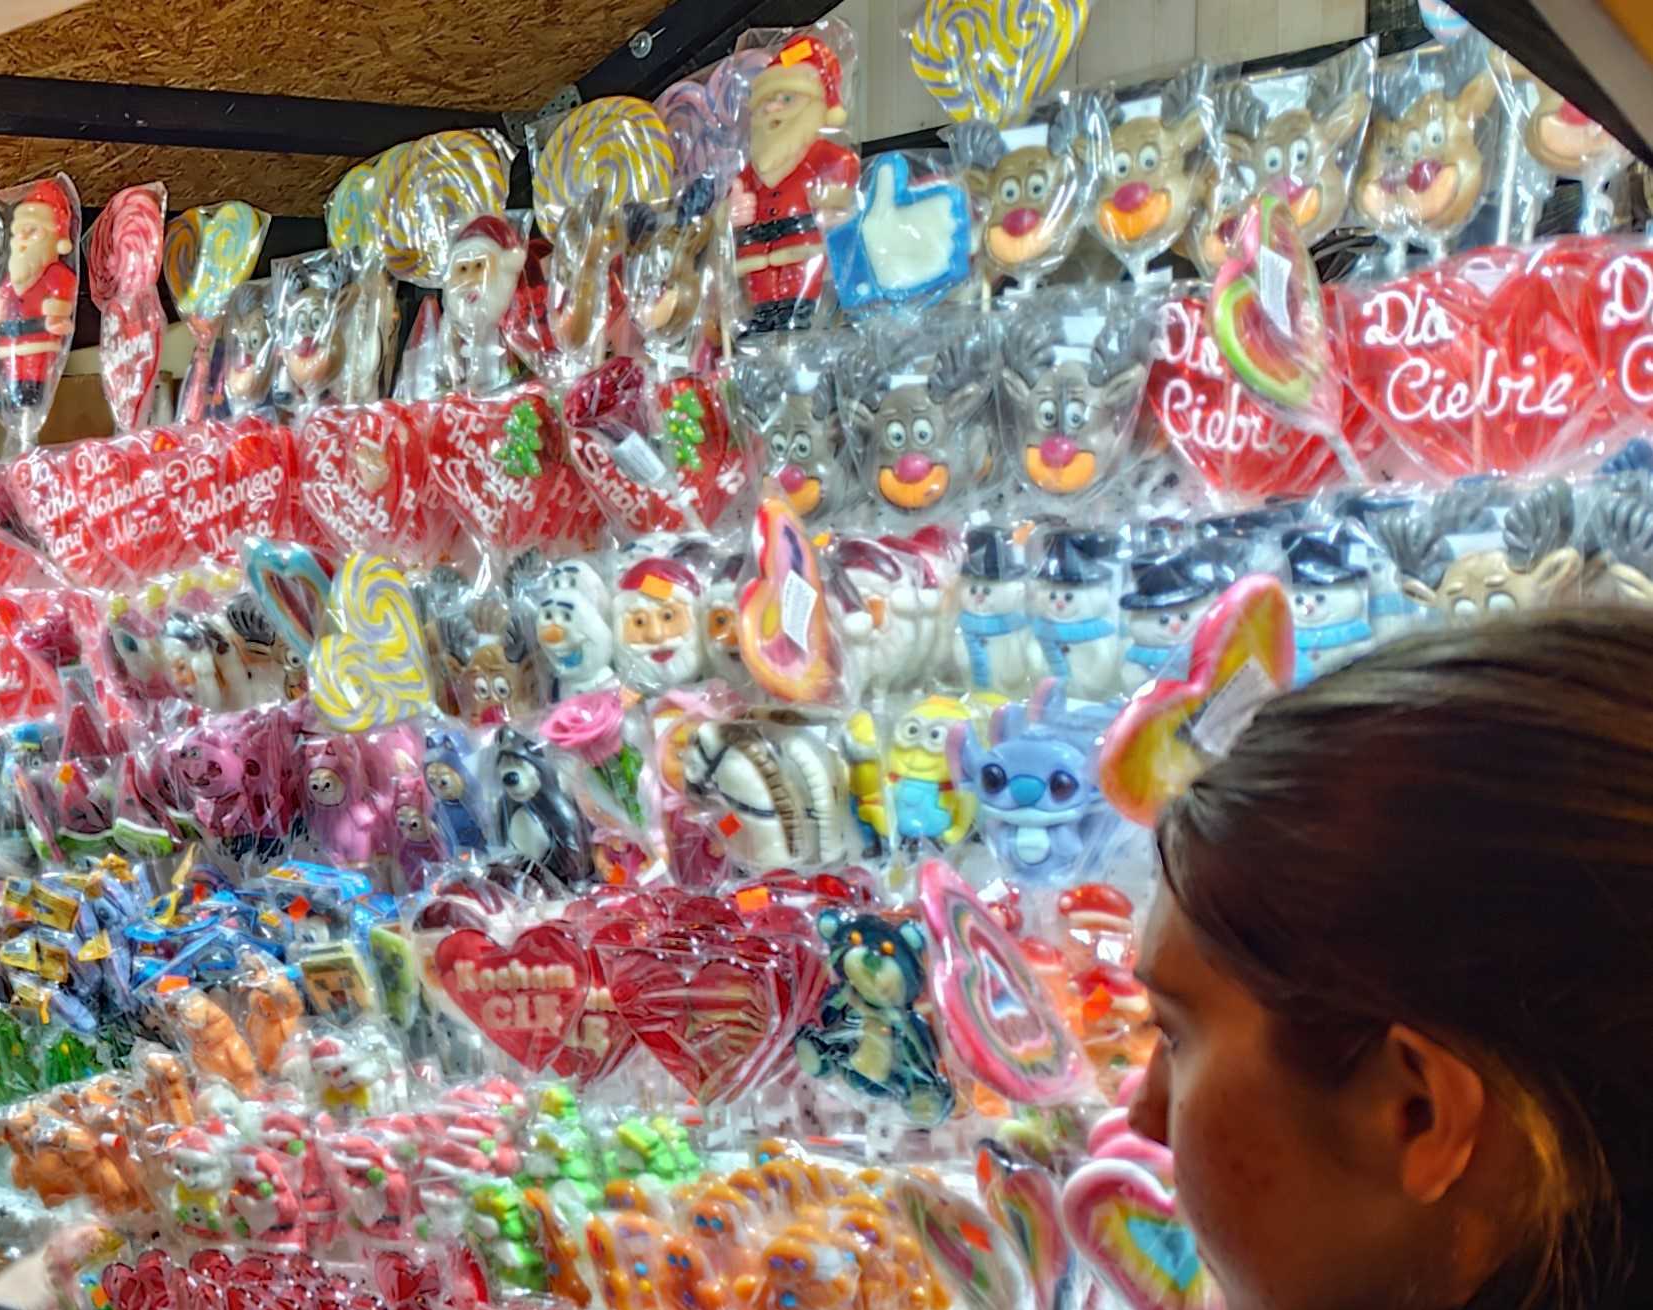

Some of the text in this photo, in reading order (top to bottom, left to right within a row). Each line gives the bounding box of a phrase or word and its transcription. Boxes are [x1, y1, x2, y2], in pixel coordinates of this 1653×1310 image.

[1150, 302, 1224, 376] Dla
[1363, 283, 1455, 346] Dla
[1387, 348, 1574, 420] Ciebie
[75, 446, 116, 485] Dla
[165, 453, 215, 493] Dla
